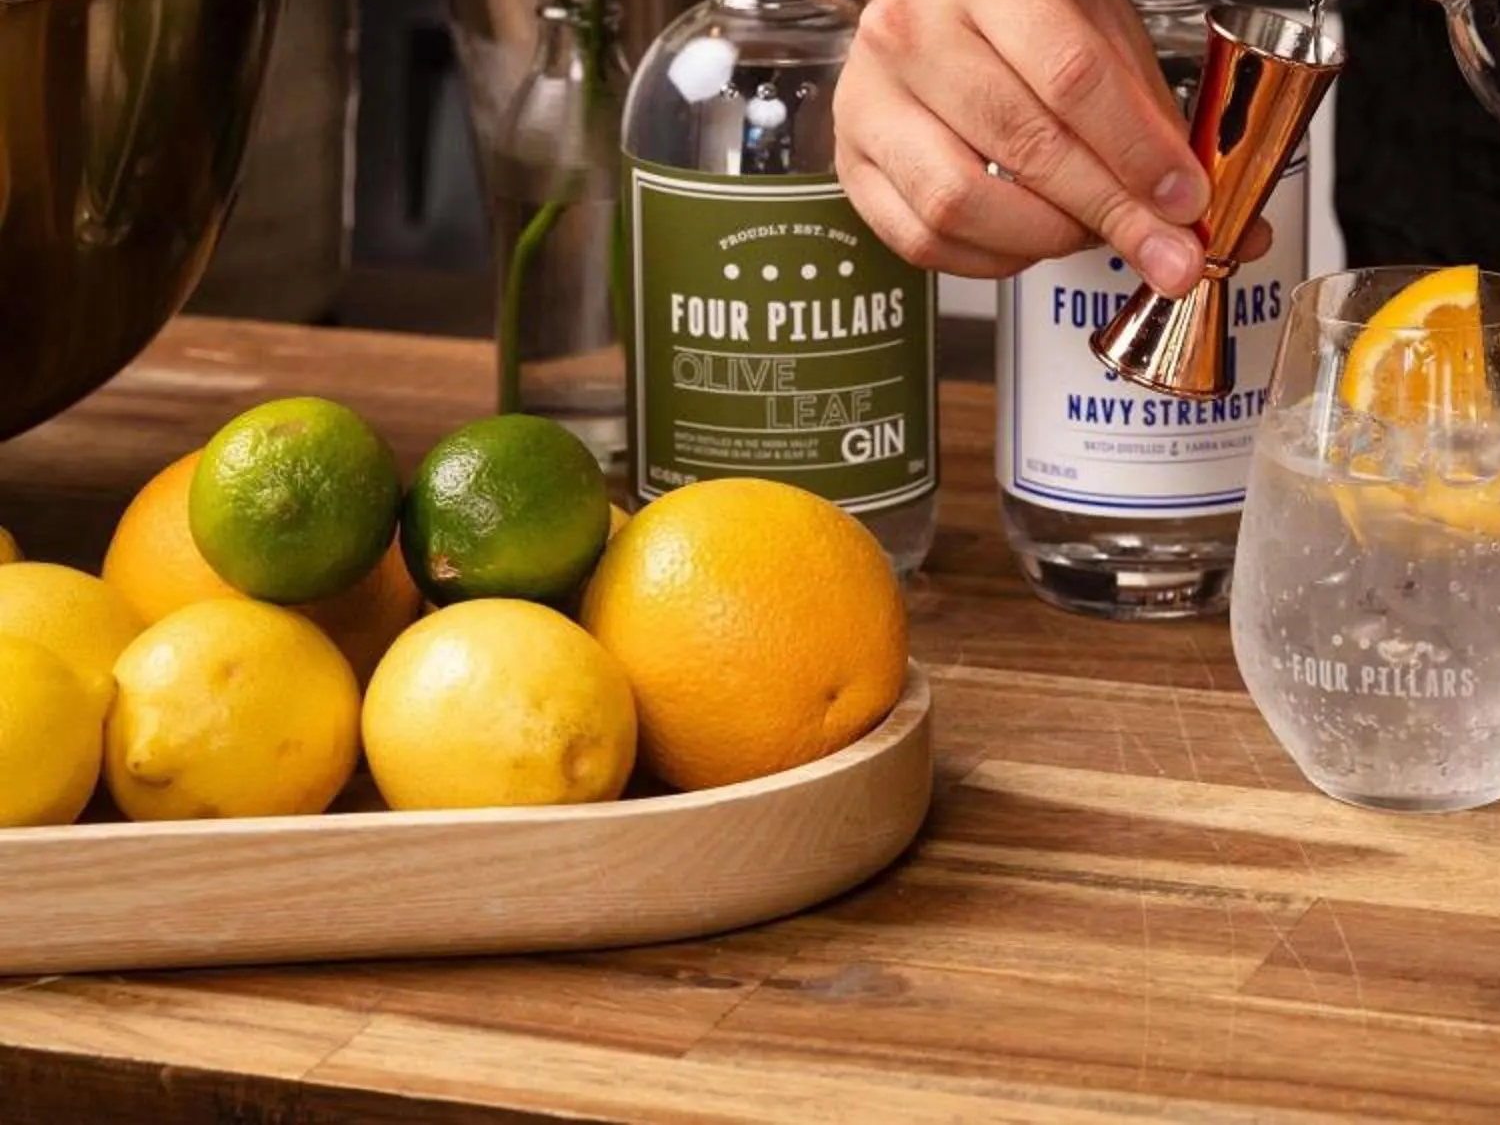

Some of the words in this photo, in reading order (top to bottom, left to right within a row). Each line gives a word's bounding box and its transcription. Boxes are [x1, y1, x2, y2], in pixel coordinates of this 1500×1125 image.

[719, 223, 788, 251] PROUDLY
[671, 293, 750, 342] FOUR
[767, 288, 905, 342] PILLARS
[672, 352, 798, 394] OLIVE
[766, 387, 873, 429] LEAF
[1068, 393, 1135, 427] NAVY
[841, 418, 905, 463] GIN
[1292, 654, 1349, 693] FOUR
[1361, 666, 1475, 698] PILLARS
